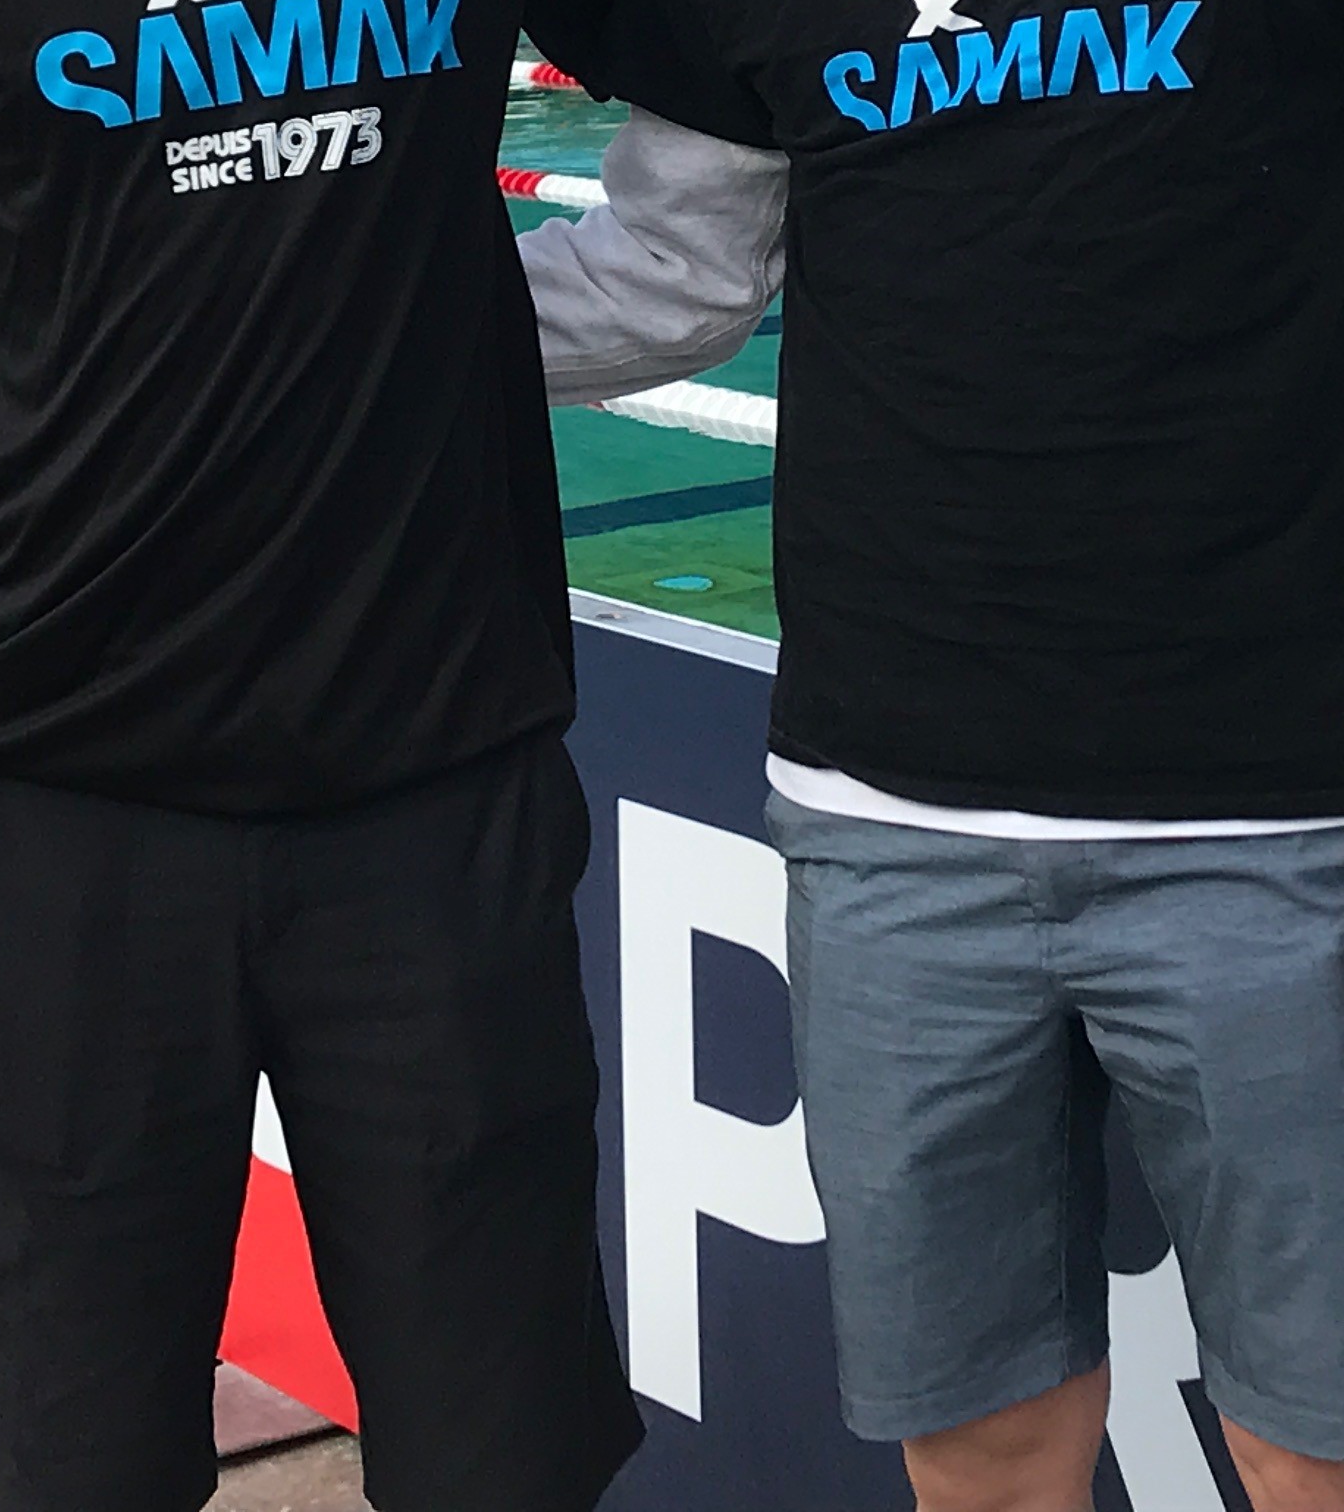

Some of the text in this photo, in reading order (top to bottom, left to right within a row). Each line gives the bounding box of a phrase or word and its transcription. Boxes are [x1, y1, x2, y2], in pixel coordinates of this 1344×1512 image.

[822, 0, 1203, 132] SAMAK
[165, 106, 383, 181] DEPUIS 1973
[172, 156, 254, 194] SINCE
